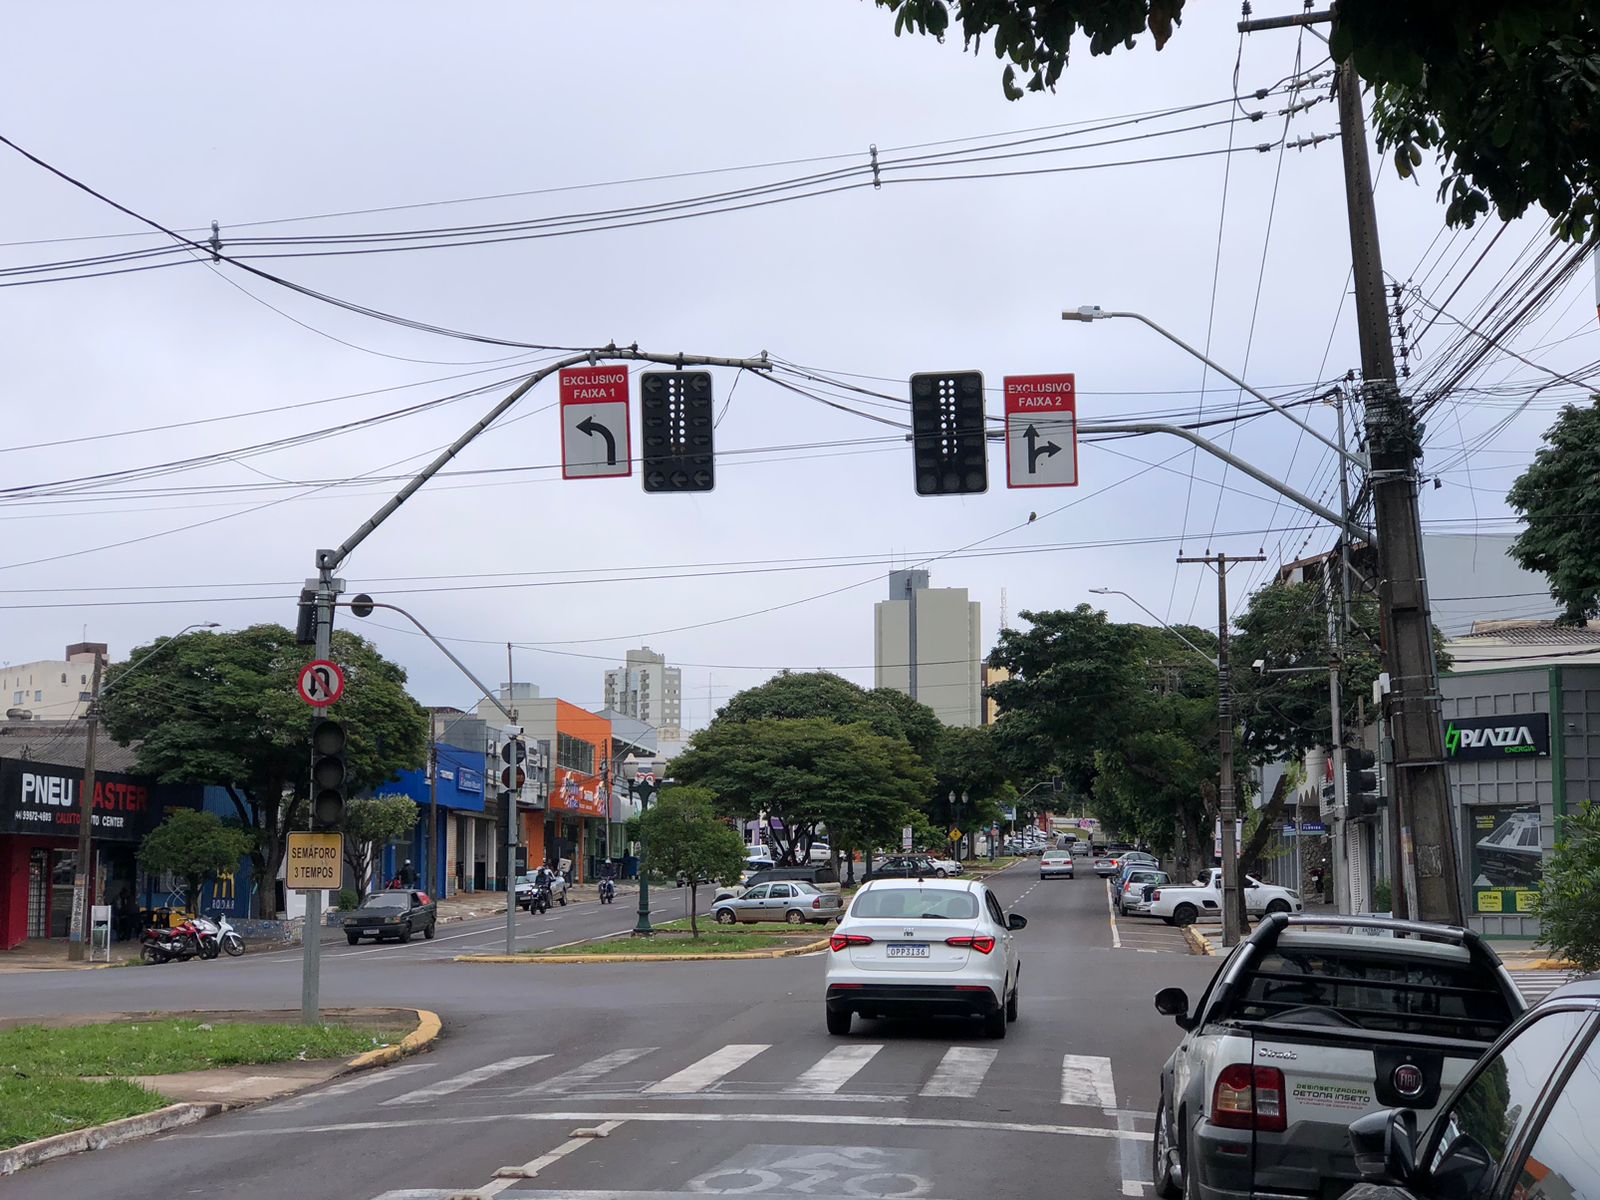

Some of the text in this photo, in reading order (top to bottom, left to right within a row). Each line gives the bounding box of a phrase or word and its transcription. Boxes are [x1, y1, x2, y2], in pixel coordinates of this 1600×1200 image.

[563, 374, 625, 386] EXCLUSIVO
[573, 388, 616, 399] FAIXA 1
[1008, 382, 1072, 394] EXCLUSIVO
[1018, 396, 1063, 407] FAIXA 2
[1460, 726, 1535, 748] PLAZZA
[21, 772, 147, 812] PNEU ASTER
[101, 815, 124, 828] CENTER
[291, 844, 337, 859] SEMÁFORO
[294, 866, 334, 879] 3 TEMPOS
[890, 948, 926, 957] OPP3136
[1258, 1047, 1298, 1061] Strada
[1400, 1073, 1417, 1088] FIAT
[1292, 1089, 1333, 1100] DETONA
[1334, 1094, 1371, 1103] INSETO
[1296, 1083, 1369, 1096] DESINSETIZADORA
